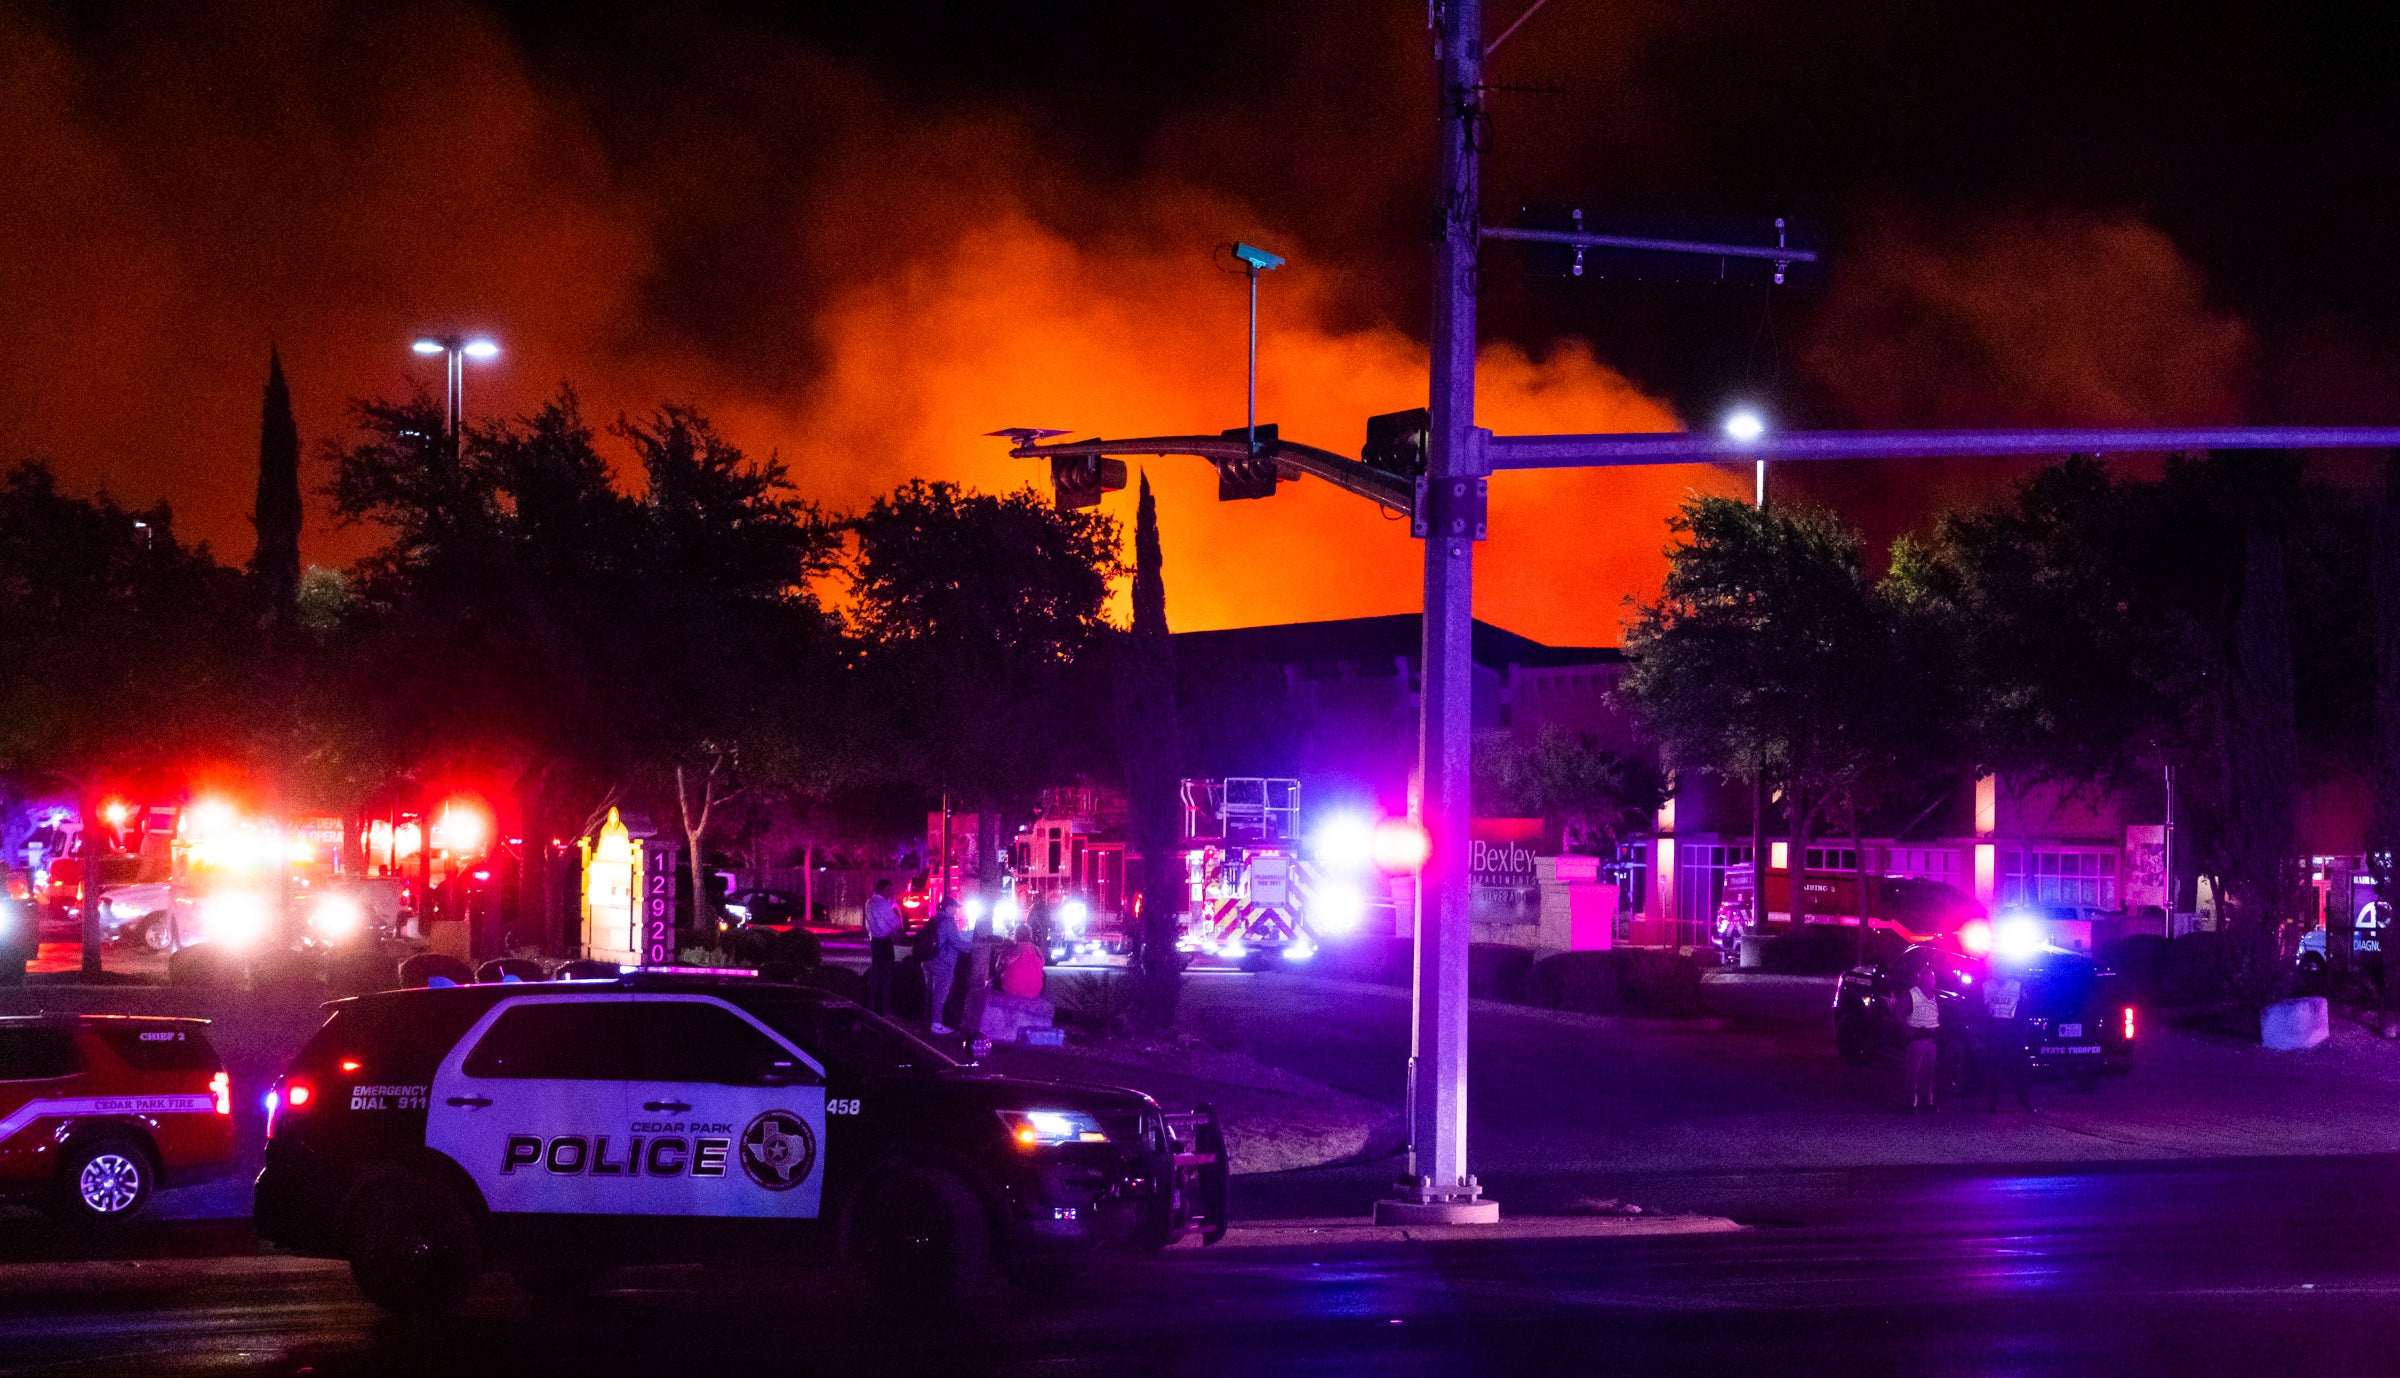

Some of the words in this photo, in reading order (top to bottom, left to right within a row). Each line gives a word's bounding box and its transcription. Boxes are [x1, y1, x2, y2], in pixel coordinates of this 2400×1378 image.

[317, 818, 344, 830] DEPA
[310, 831, 344, 843] OPERA
[1473, 840, 1536, 873] Bexley
[1473, 874, 1537, 885] APARTMENTS
[651, 852, 666, 963] 12920
[140, 1032, 175, 1041] CHIEF
[178, 1032, 185, 1040] 2
[352, 1085, 428, 1096] EMERGENCY
[94, 1101, 132, 1110] CEDAR
[136, 1100, 165, 1109] PARK
[168, 1099, 194, 1108] FIRE
[350, 1097, 388, 1110] DIAL
[397, 1096, 427, 1109] 911
[826, 1098, 861, 1115] 458
[630, 1122, 685, 1133] CEDAR
[689, 1123, 734, 1134] PARK
[500, 1133, 732, 1178] POLICE
